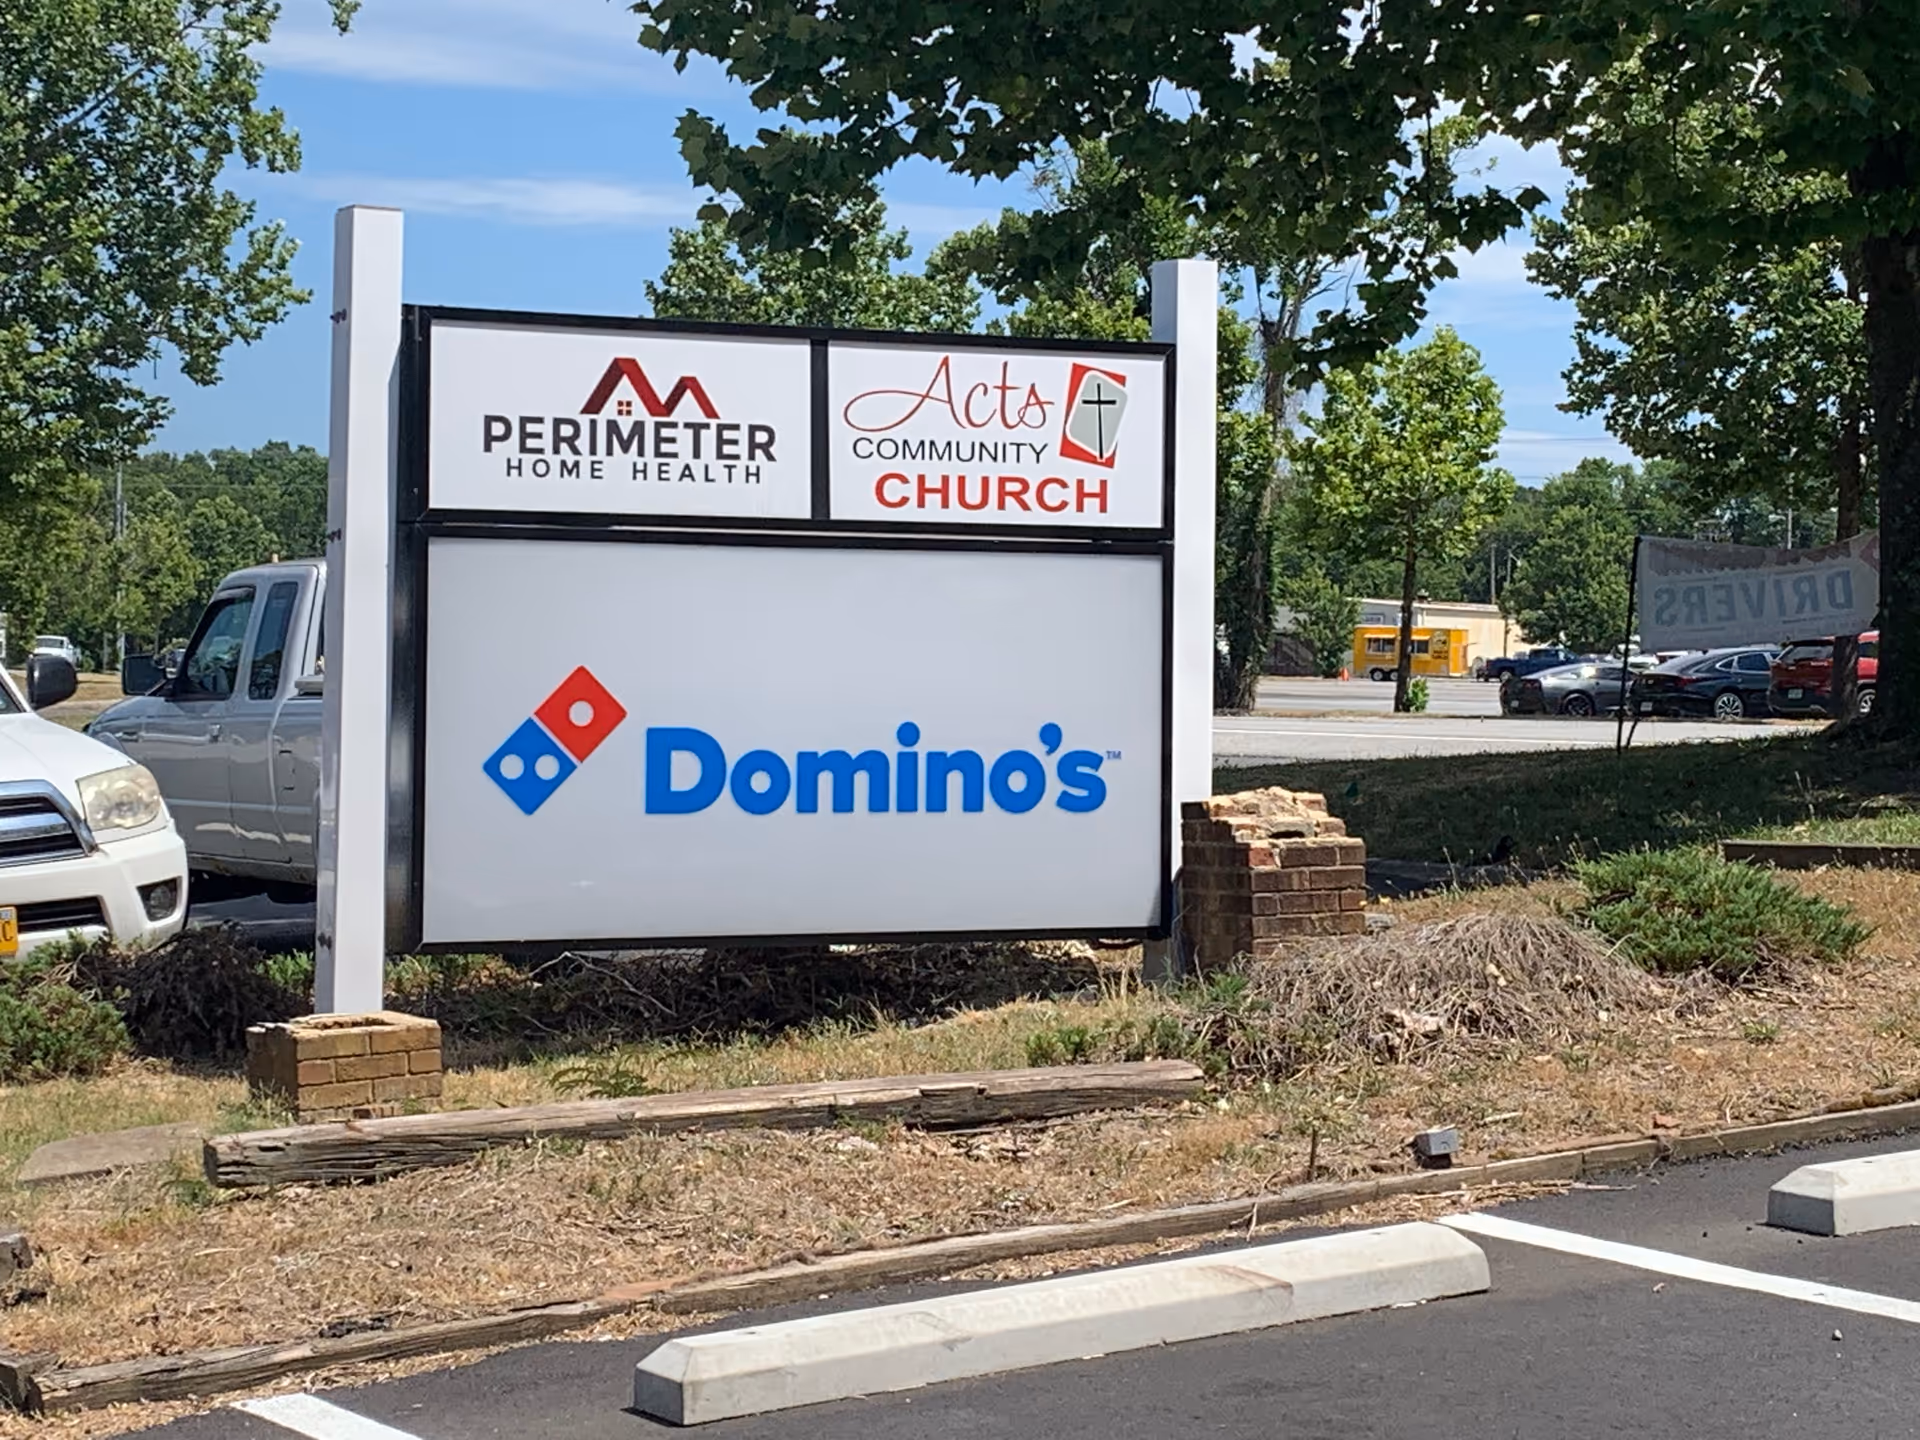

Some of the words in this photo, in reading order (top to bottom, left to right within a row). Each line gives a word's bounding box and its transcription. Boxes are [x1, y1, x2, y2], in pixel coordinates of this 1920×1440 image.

[843, 355, 1055, 432] Acts
[483, 414, 777, 462] PERIMETER
[852, 437, 1048, 463] COMMUNITY
[506, 457, 604, 480] HOME
[632, 462, 760, 484] HEALTH
[874, 472, 1108, 514] CHURCH
[645, 721, 1107, 814] Domino's
